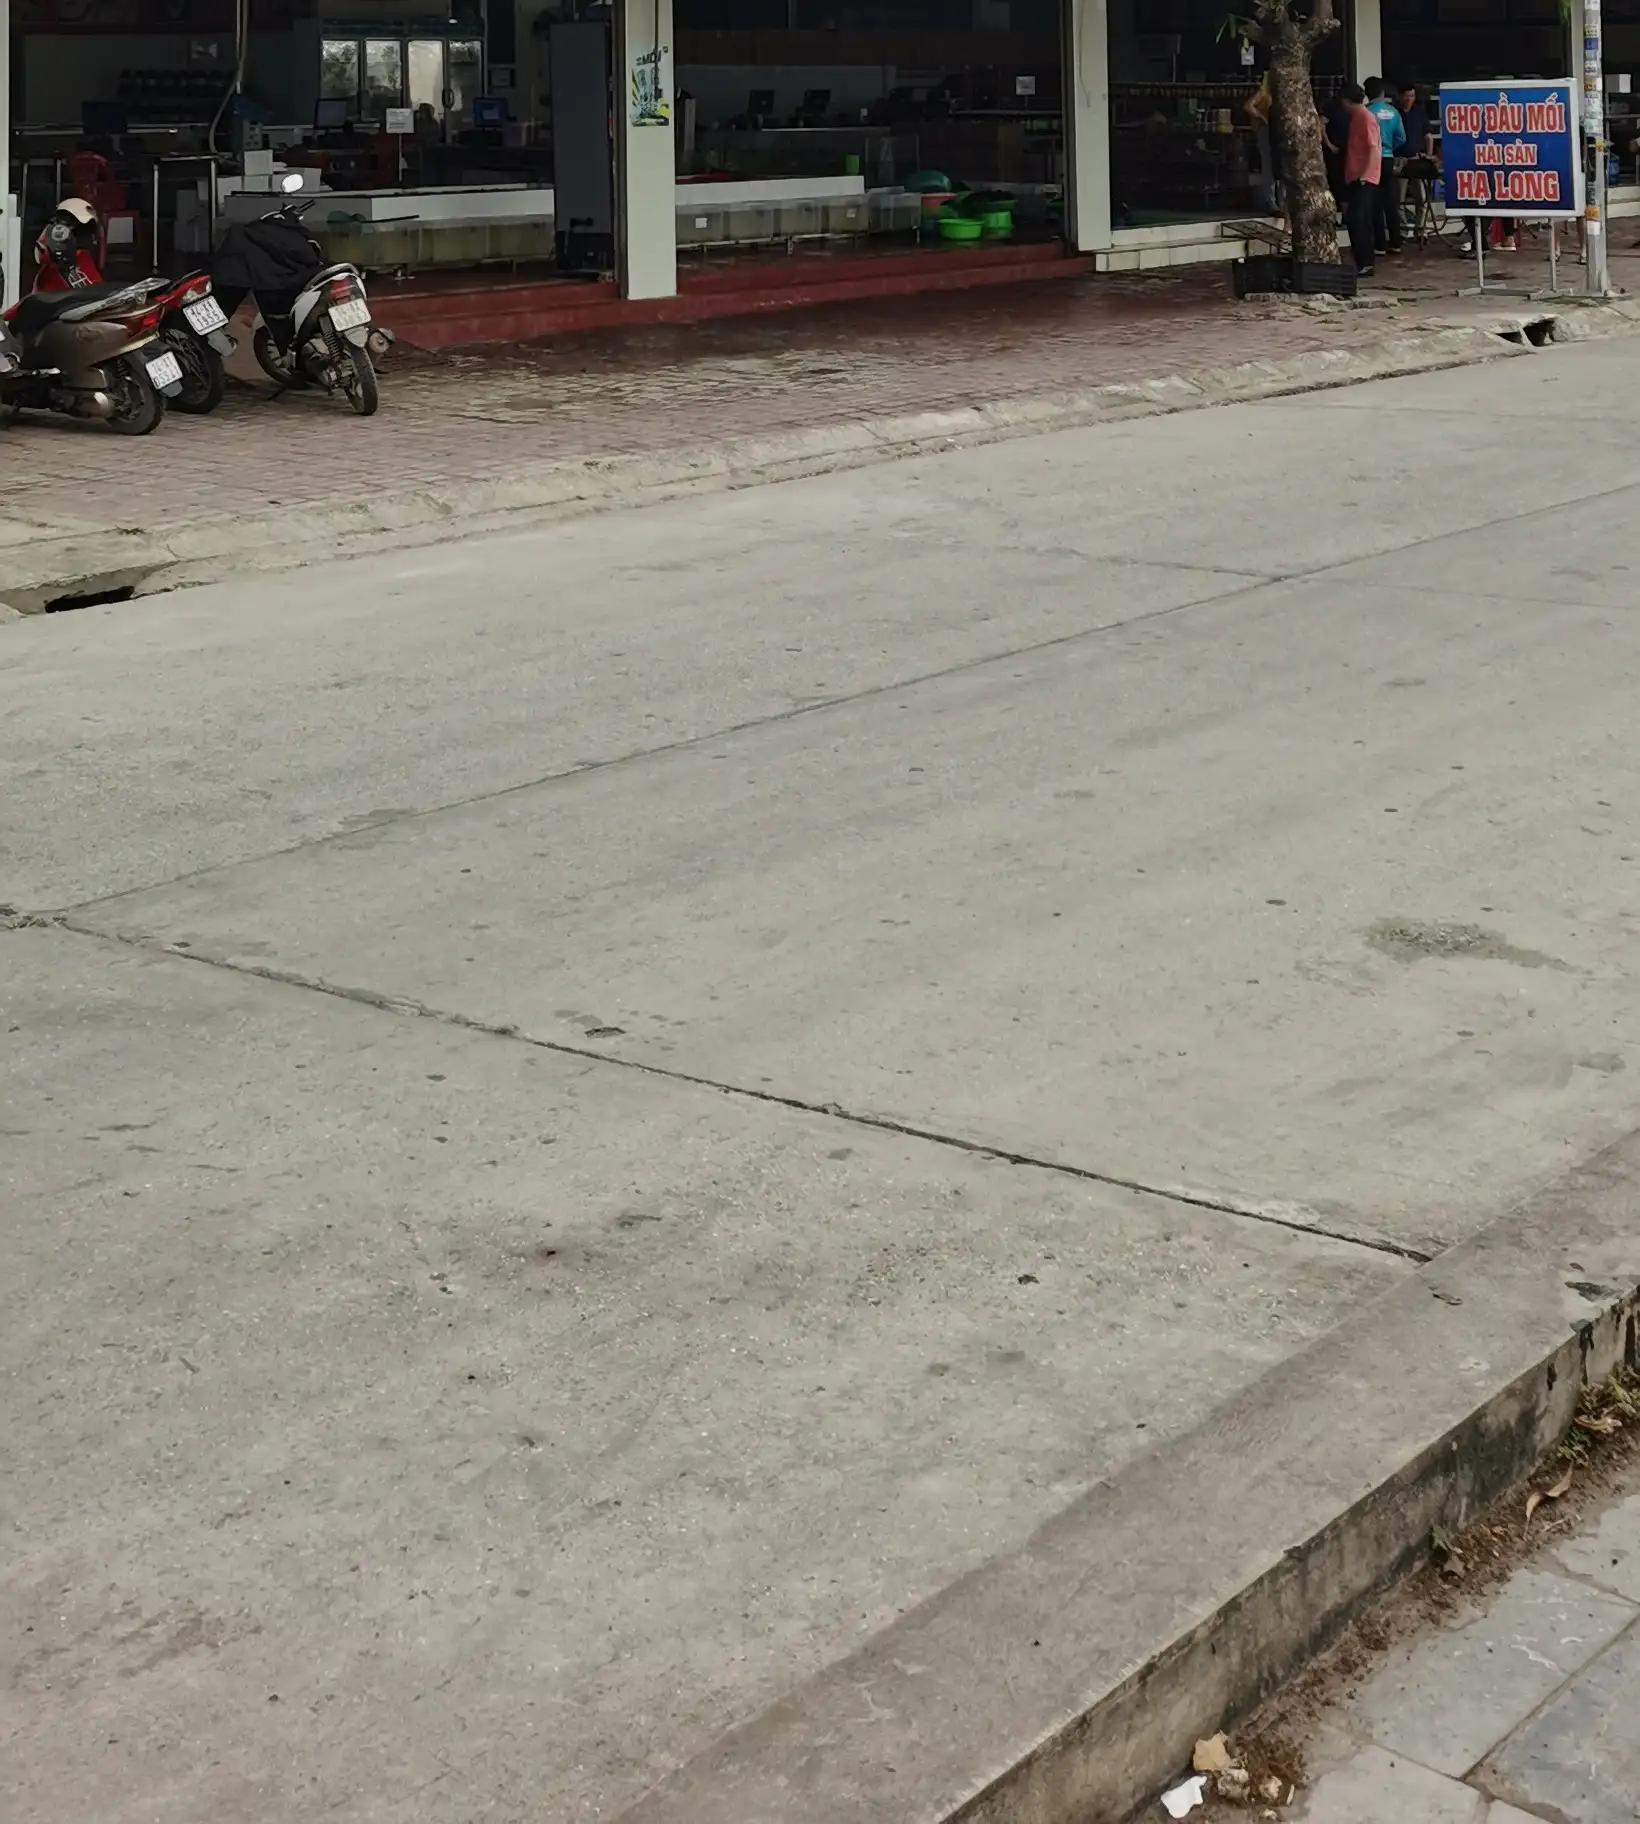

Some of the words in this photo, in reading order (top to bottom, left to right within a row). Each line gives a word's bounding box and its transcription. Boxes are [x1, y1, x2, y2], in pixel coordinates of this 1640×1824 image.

[1445, 104, 1483, 138] CHỢ
[1484, 92, 1523, 133] ĐẦU
[1525, 92, 1566, 133] MỐI
[1456, 170, 1491, 205] HẠ
[1494, 171, 1560, 201] LONG
